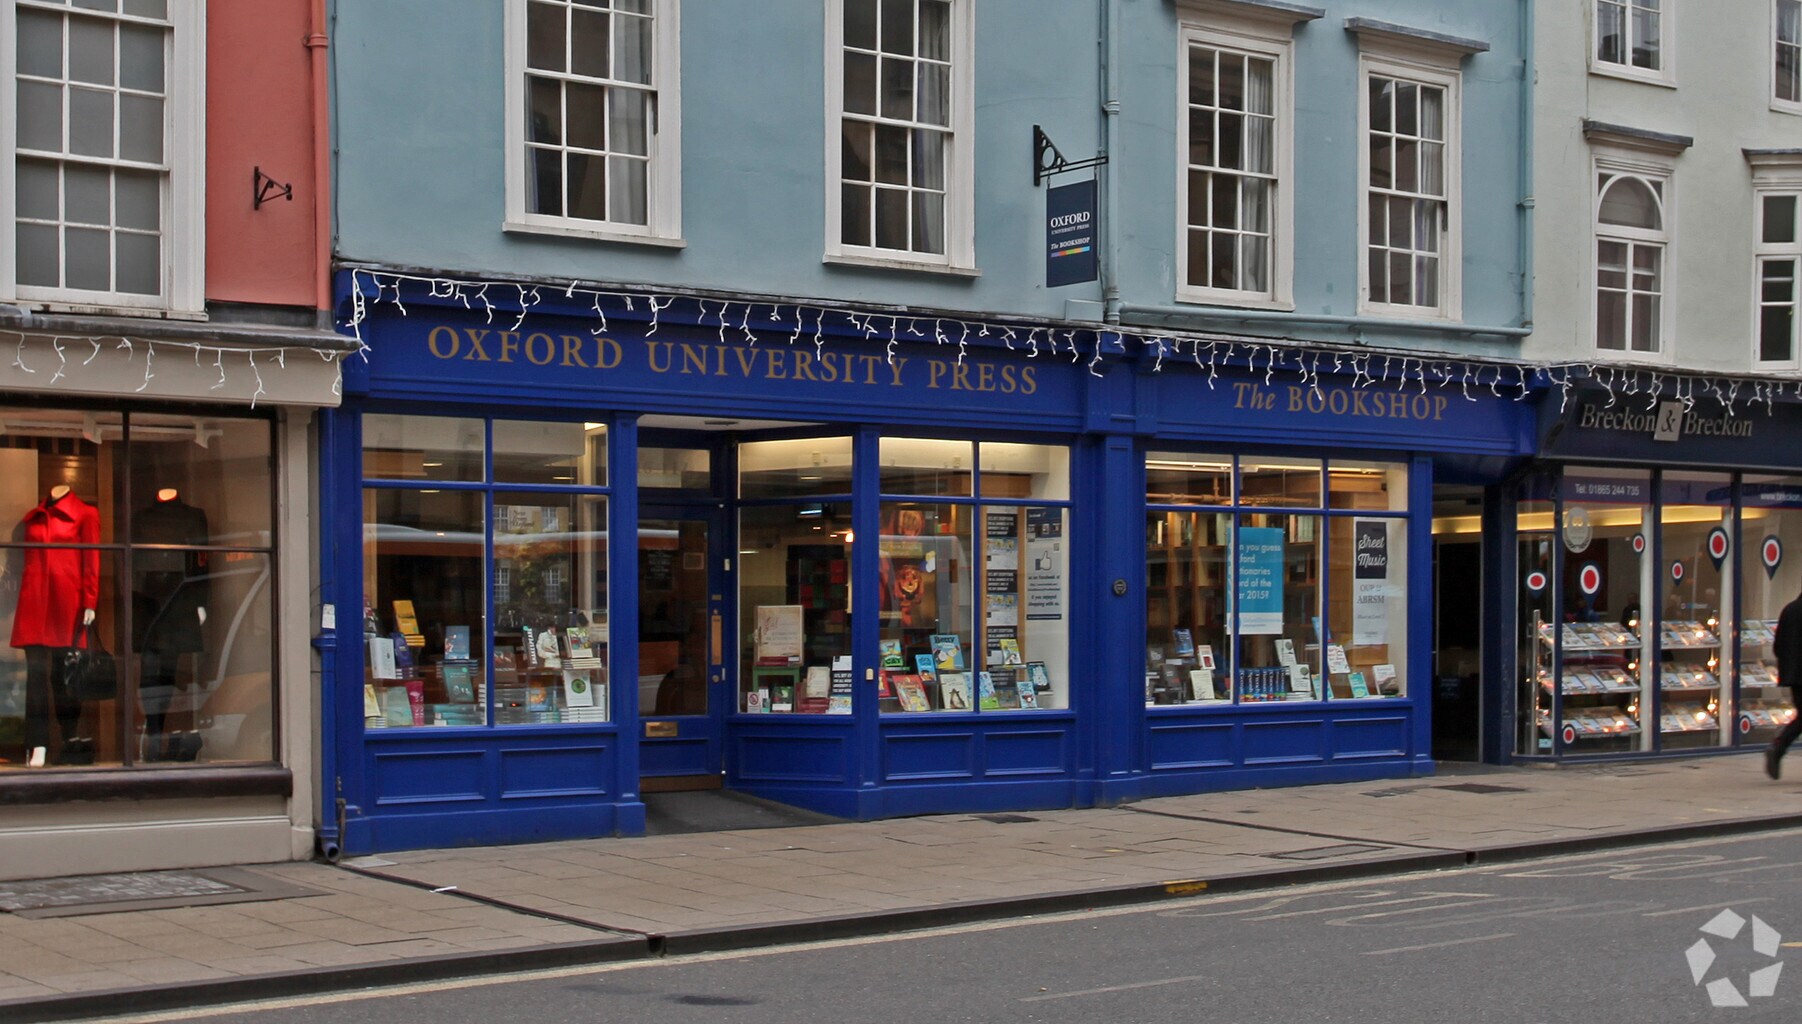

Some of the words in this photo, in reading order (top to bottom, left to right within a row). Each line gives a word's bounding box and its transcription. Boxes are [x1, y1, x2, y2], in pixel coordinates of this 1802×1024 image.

[1050, 211, 1090, 228] OXFORD
[1060, 237, 1090, 249] BOOKSHOP
[428, 325, 624, 369] OXFORD
[646, 341, 908, 387] UNIVERSITY
[926, 359, 1039, 395] PRESS
[1232, 381, 1277, 411] The
[1286, 385, 1449, 421] BOOKSHOP
[1580, 403, 1657, 432] Breckon
[1660, 409, 1677, 433] &
[1684, 411, 1754, 437] Breckon
[1611, 485, 1626, 496] 244
[1626, 486, 1640, 497] 735
[1246, 544, 1260, 553] you
[1358, 533, 1385, 551] Sheet
[1358, 553, 1386, 568] Music
[1260, 578, 1272, 587] the
[1246, 590, 1270, 600] 2015?
